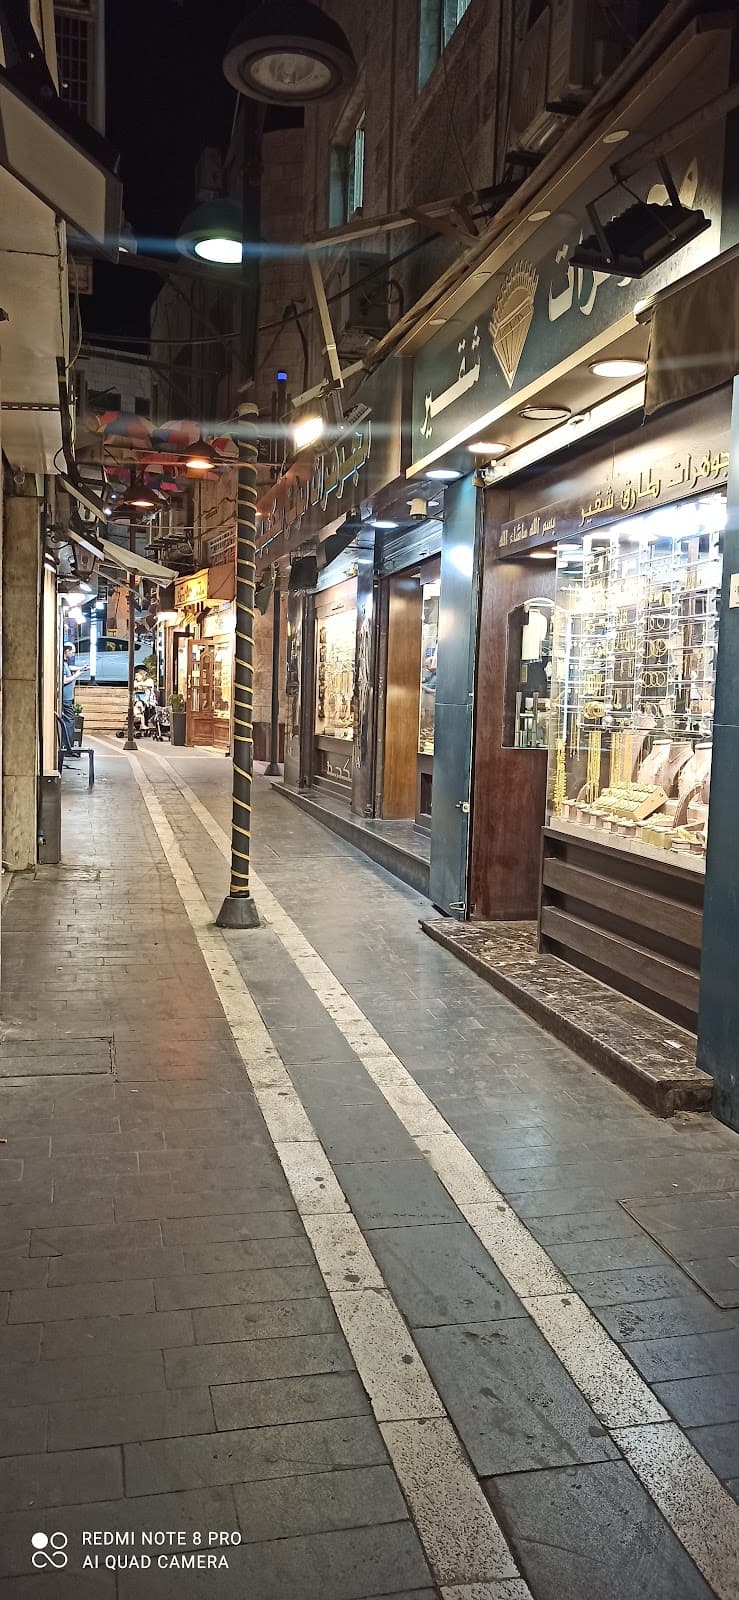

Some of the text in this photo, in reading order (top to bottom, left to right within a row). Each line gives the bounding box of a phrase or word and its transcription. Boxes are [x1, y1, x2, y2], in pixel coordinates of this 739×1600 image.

[420, 325, 481, 439] شقير
[578, 449, 730, 527] جوهرات طارق شقير
[529, 516, 541, 537] الله
[541, 517, 556, 537] بسم
[499, 529, 508, 547] الله
